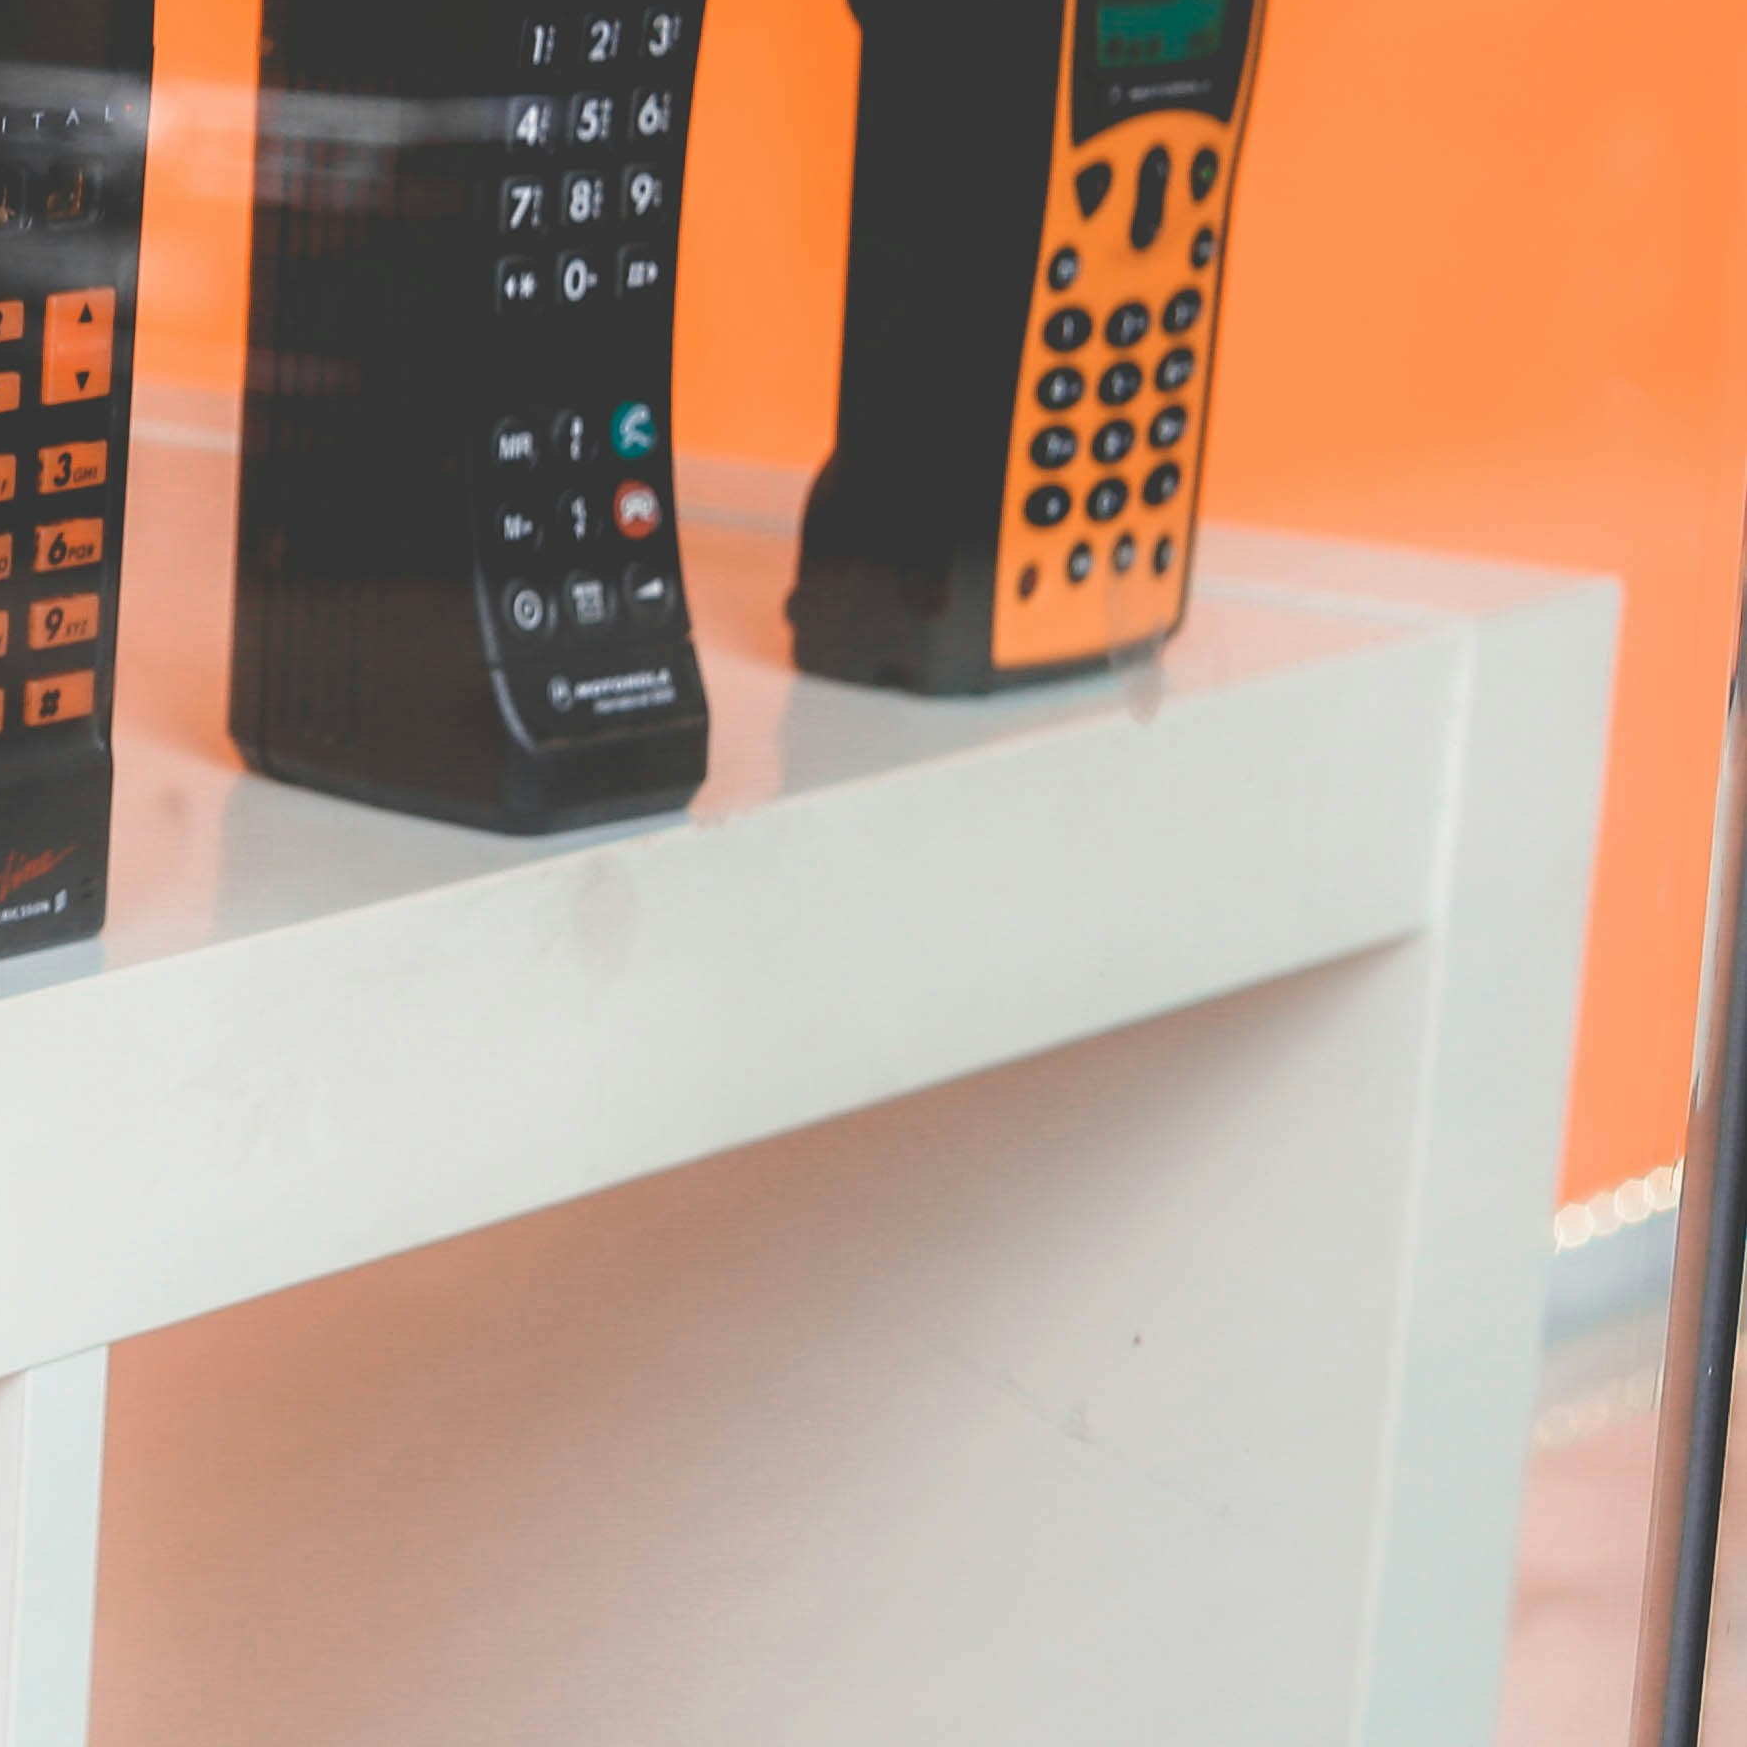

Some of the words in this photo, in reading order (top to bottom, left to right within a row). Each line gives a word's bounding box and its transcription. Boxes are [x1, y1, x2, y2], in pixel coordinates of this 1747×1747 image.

[532, 24, 544, 65] 1
[588, 20, 611, 63] 2
[649, 13, 670, 57] 3
[516, 104, 539, 147] 4
[576, 99, 601, 143] 5
[637, 92, 660, 136] 6
[510, 185, 533, 229] 7
[569, 179, 592, 224] 8
[631, 172, 655, 216] 9
[53, 452, 72, 487] 3
[48, 532, 67, 565] 6
[45, 608, 63, 642] 9
